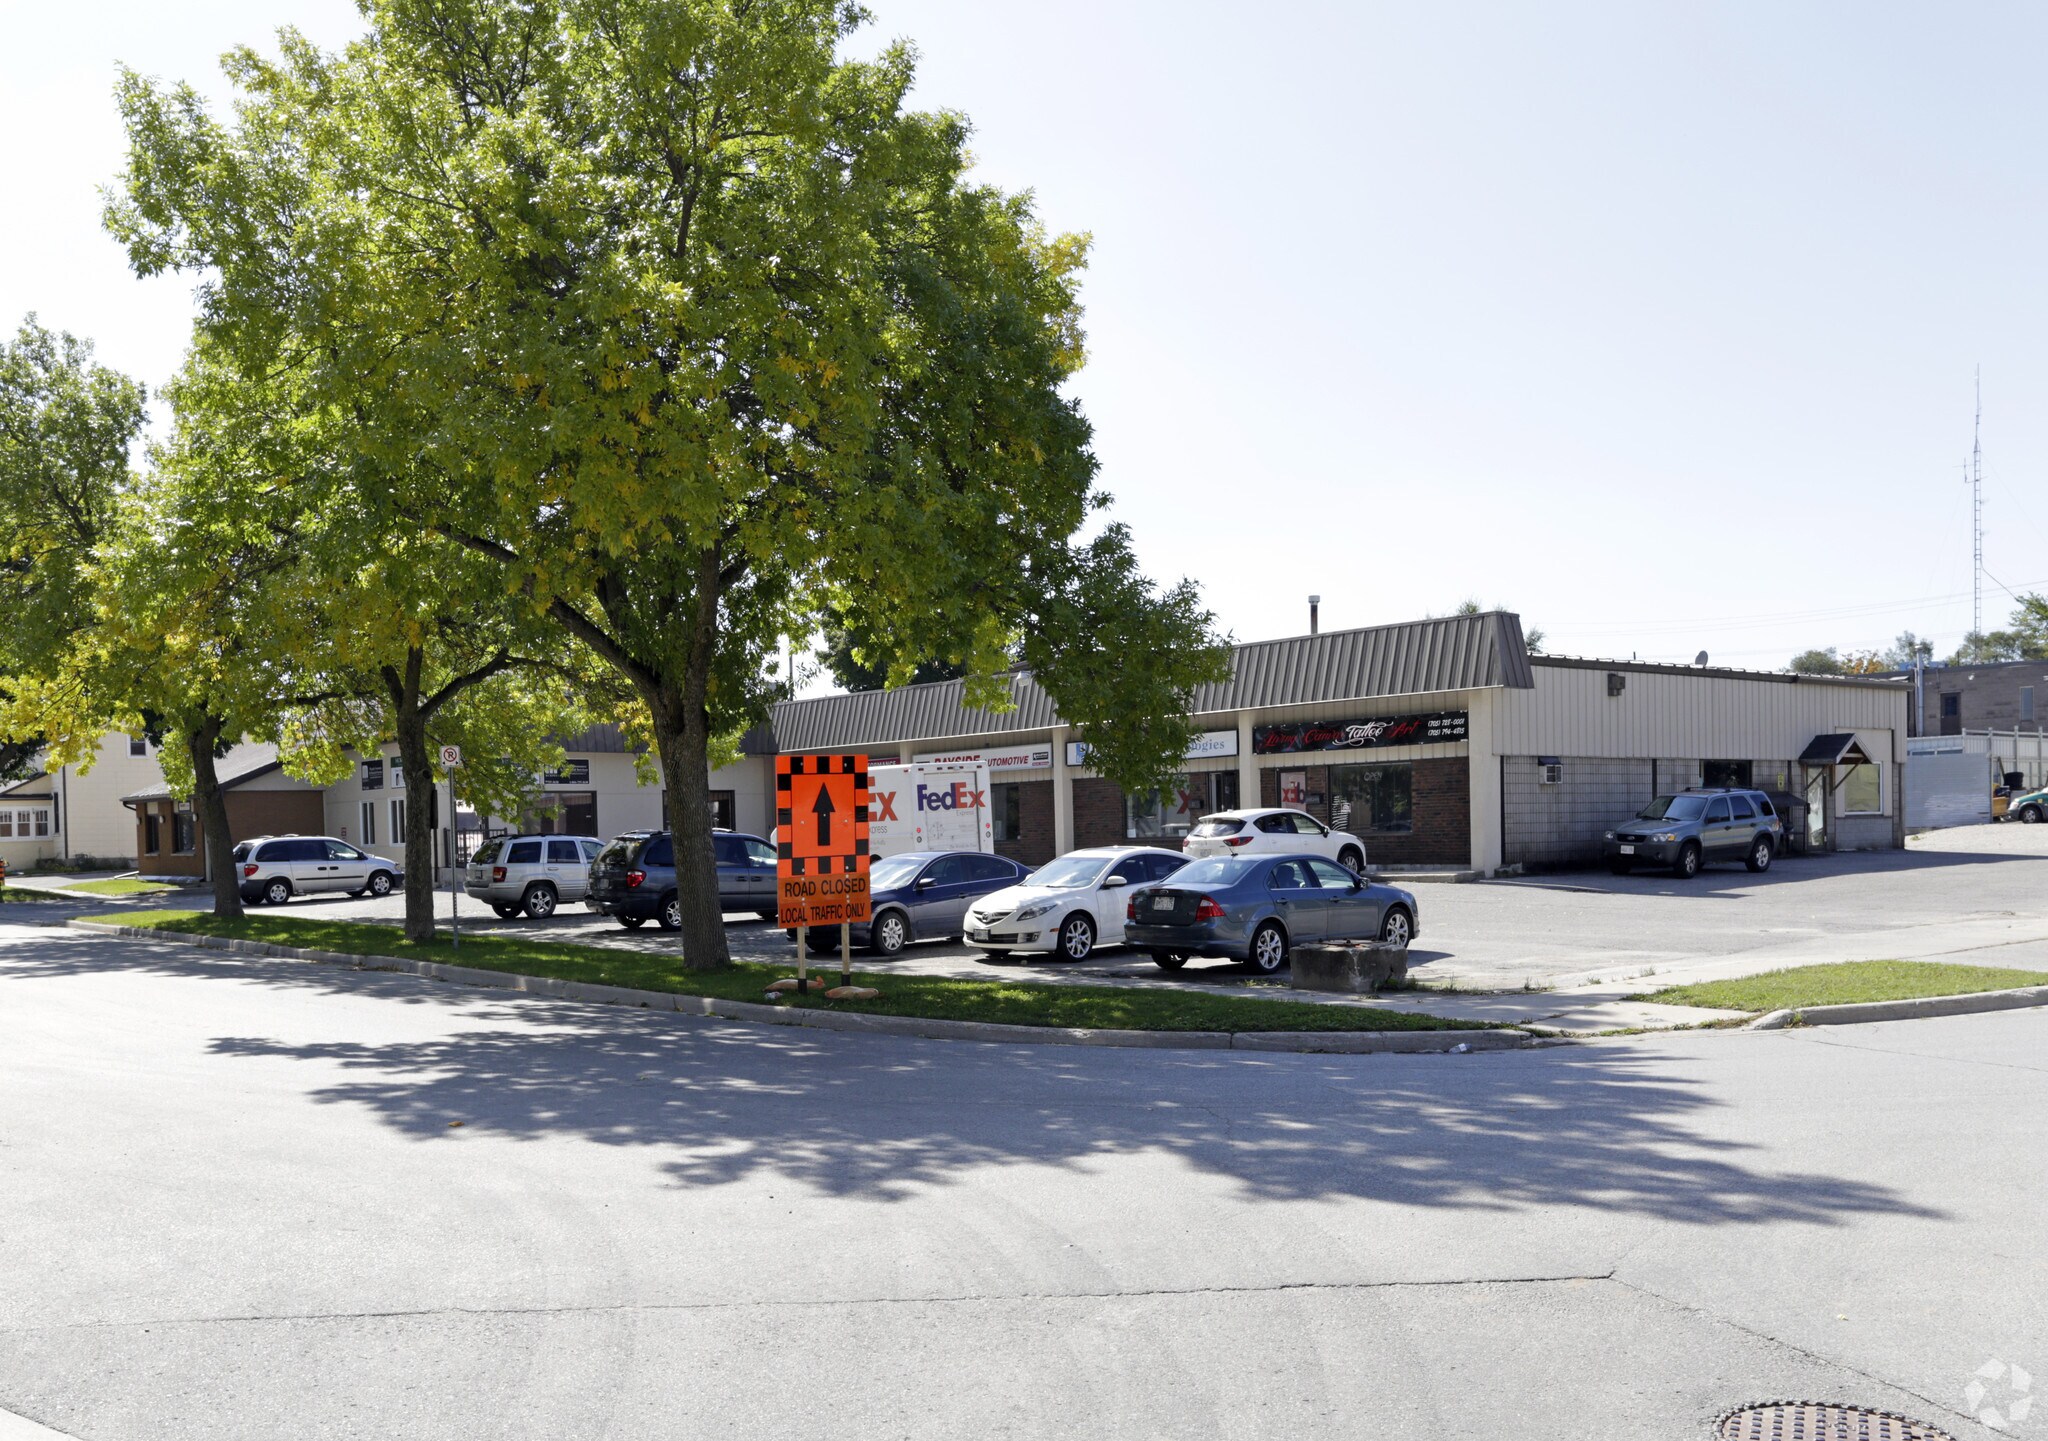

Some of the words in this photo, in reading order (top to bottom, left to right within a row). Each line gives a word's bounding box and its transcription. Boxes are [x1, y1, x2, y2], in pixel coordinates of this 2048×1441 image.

[1386, 720, 1422, 738] Art
[987, 755, 1029, 767] UTOMOTIVE
[917, 782, 986, 811] FedEx
[784, 881, 816, 898] ROAD
[821, 878, 866, 895] CLOSED
[780, 907, 807, 923] LOCAL
[810, 904, 842, 920] TRAFFIC
[845, 903, 866, 918] ONLY
